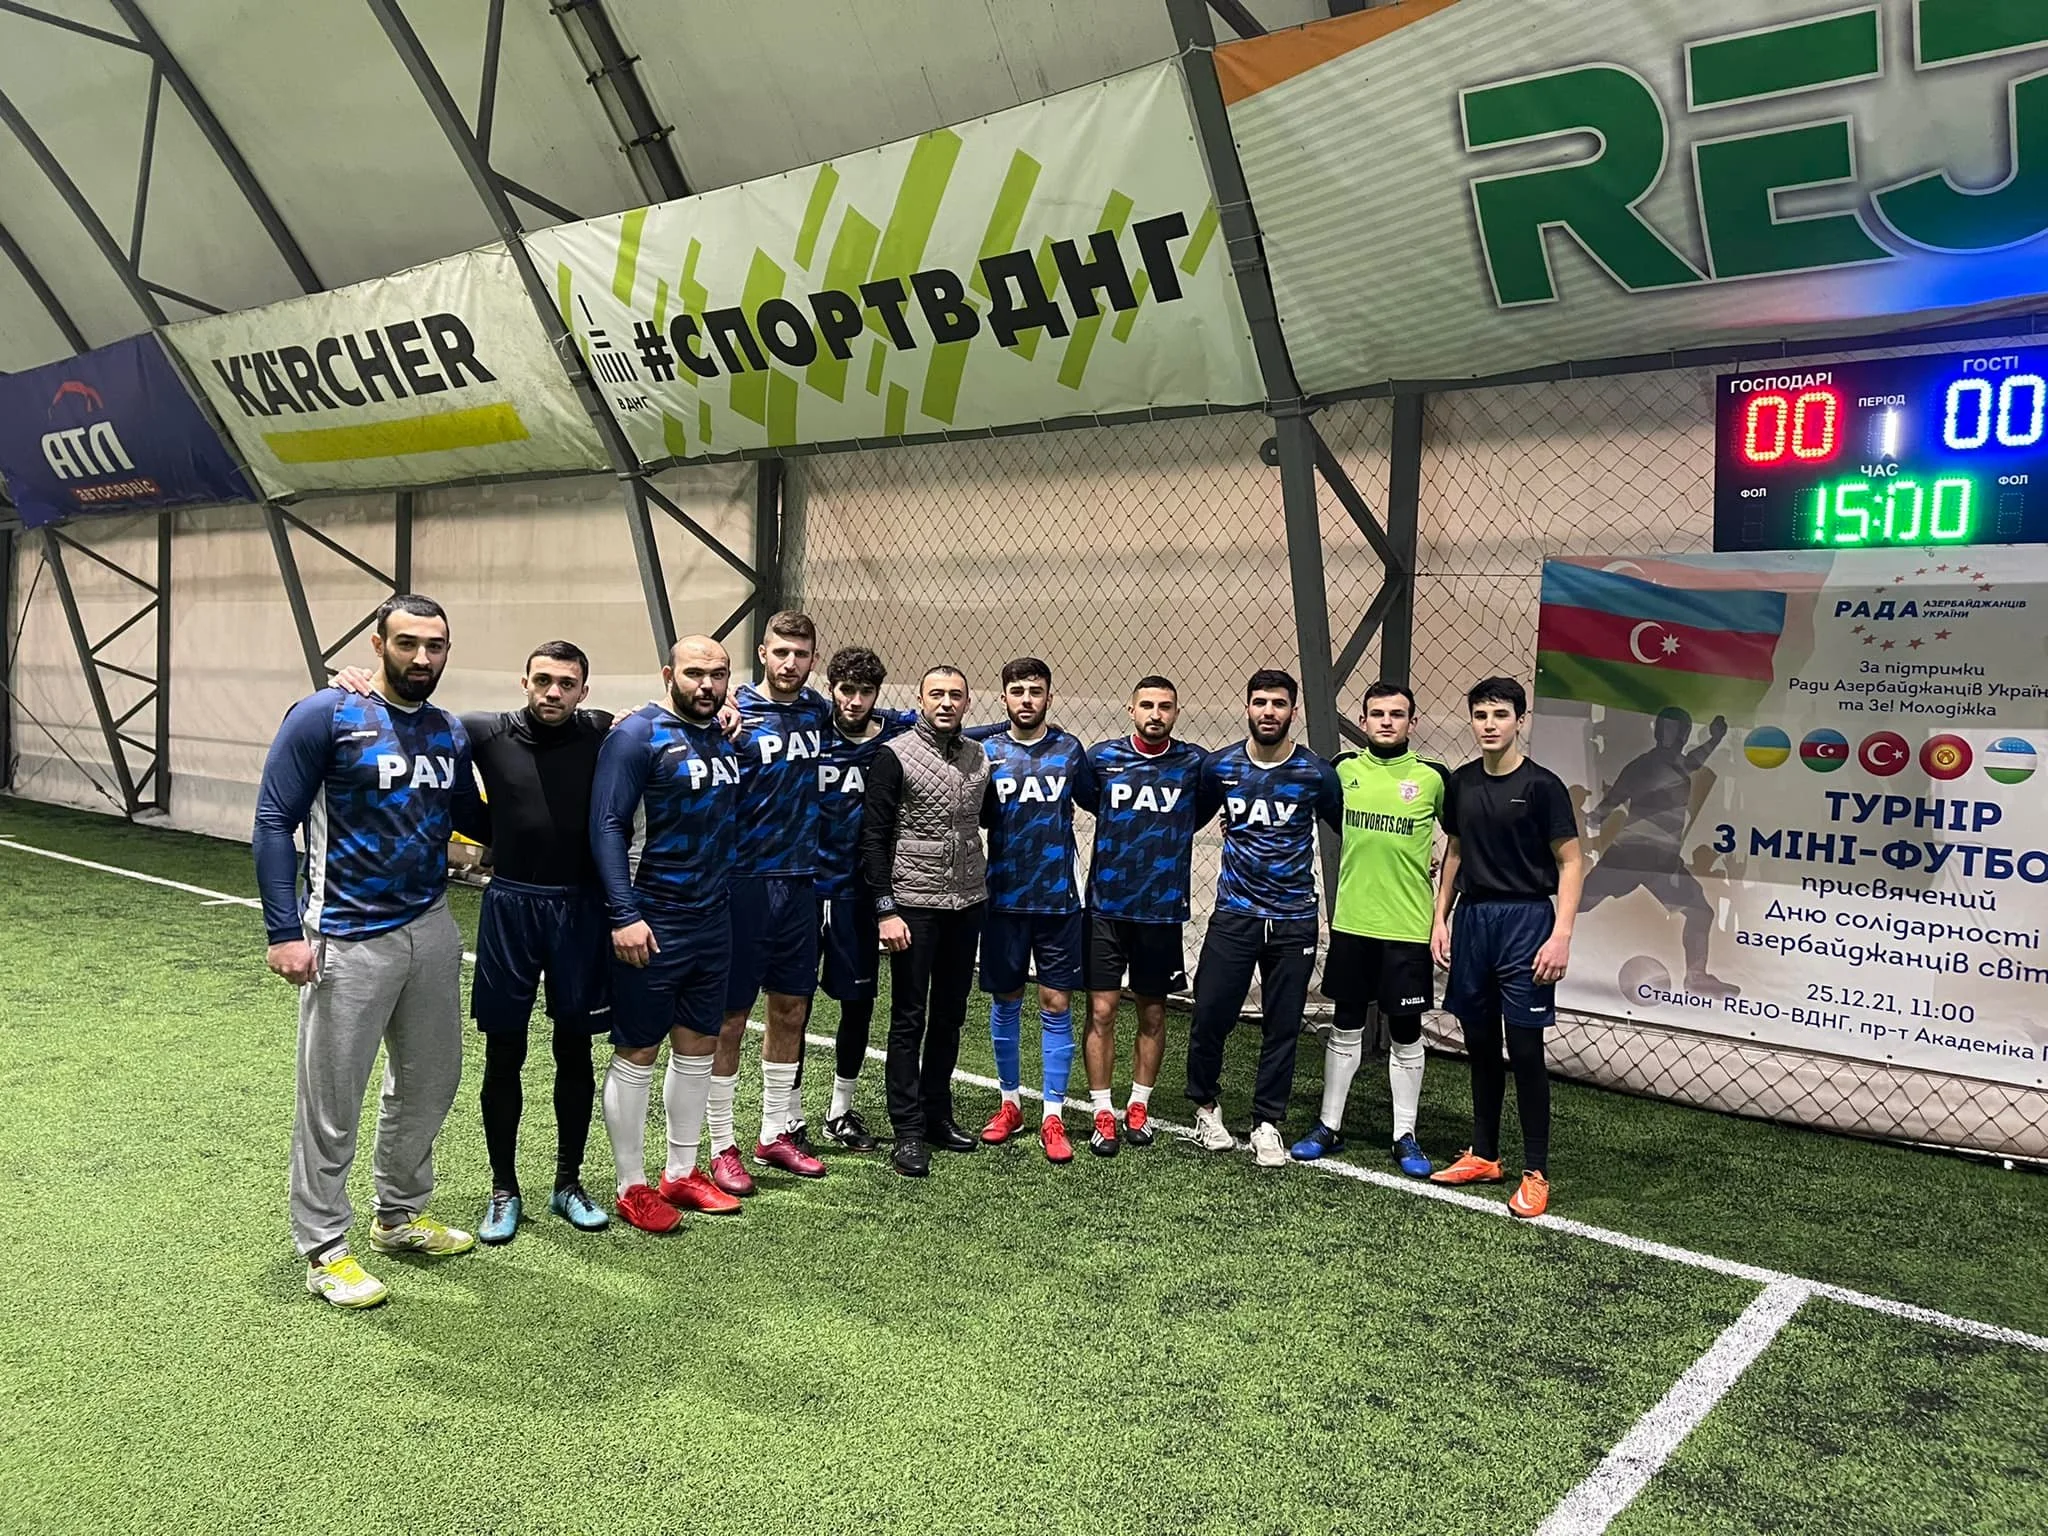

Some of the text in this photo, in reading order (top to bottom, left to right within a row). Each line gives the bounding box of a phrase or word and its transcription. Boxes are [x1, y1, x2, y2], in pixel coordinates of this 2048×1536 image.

[634, 211, 1189, 382] #СПОРТВДНГ
[211, 313, 497, 417] KÄRCHER
[1962, 356, 2019, 372] ГОСТІ
[1730, 372, 1833, 394] ГОСПОДАРІ
[616, 396, 649, 412] ВДНГ
[1858, 394, 1906, 408] ПЕРІОД
[1943, 374, 2047, 450] 00
[1744, 391, 1836, 461] 00
[1861, 463, 1899, 478] ЧАС
[1998, 474, 2029, 486] ФОЛ
[1740, 487, 1767, 498] ФОЛ
[1834, 600, 1919, 620] РАДА
[1922, 608, 1969, 619] УКРАЇНИ
[1923, 599, 2026, 609] АЗЕРБАЙДЖАНЦІВ
[1859, 660, 1985, 677] За підтримки
[1789, 678, 1830, 693] Ради
[1834, 679, 1983, 698] Азербайджанців
[1838, 700, 1863, 711] та
[1899, 701, 1996, 718] Молодіжка
[818, 764, 868, 793] РА
[1825, 791, 2003, 832] ТУРНІР
[1750, 827, 2048, 883] МІНІ-ФУТБО
[1801, 875, 1997, 912] присвячений
[1765, 900, 2040, 950] Дню солідарності
[1736, 928, 1969, 974] азербайджанців
[1806, 983, 1975, 1024] 25.12.21, 11:00
[1637, 984, 1713, 1009] Стадіон
[1724, 998, 1853, 1034] REJO-ВДНГ,
[1860, 1023, 1909, 1043] пр-т
[1914, 1028, 2034, 1060] Академіка
